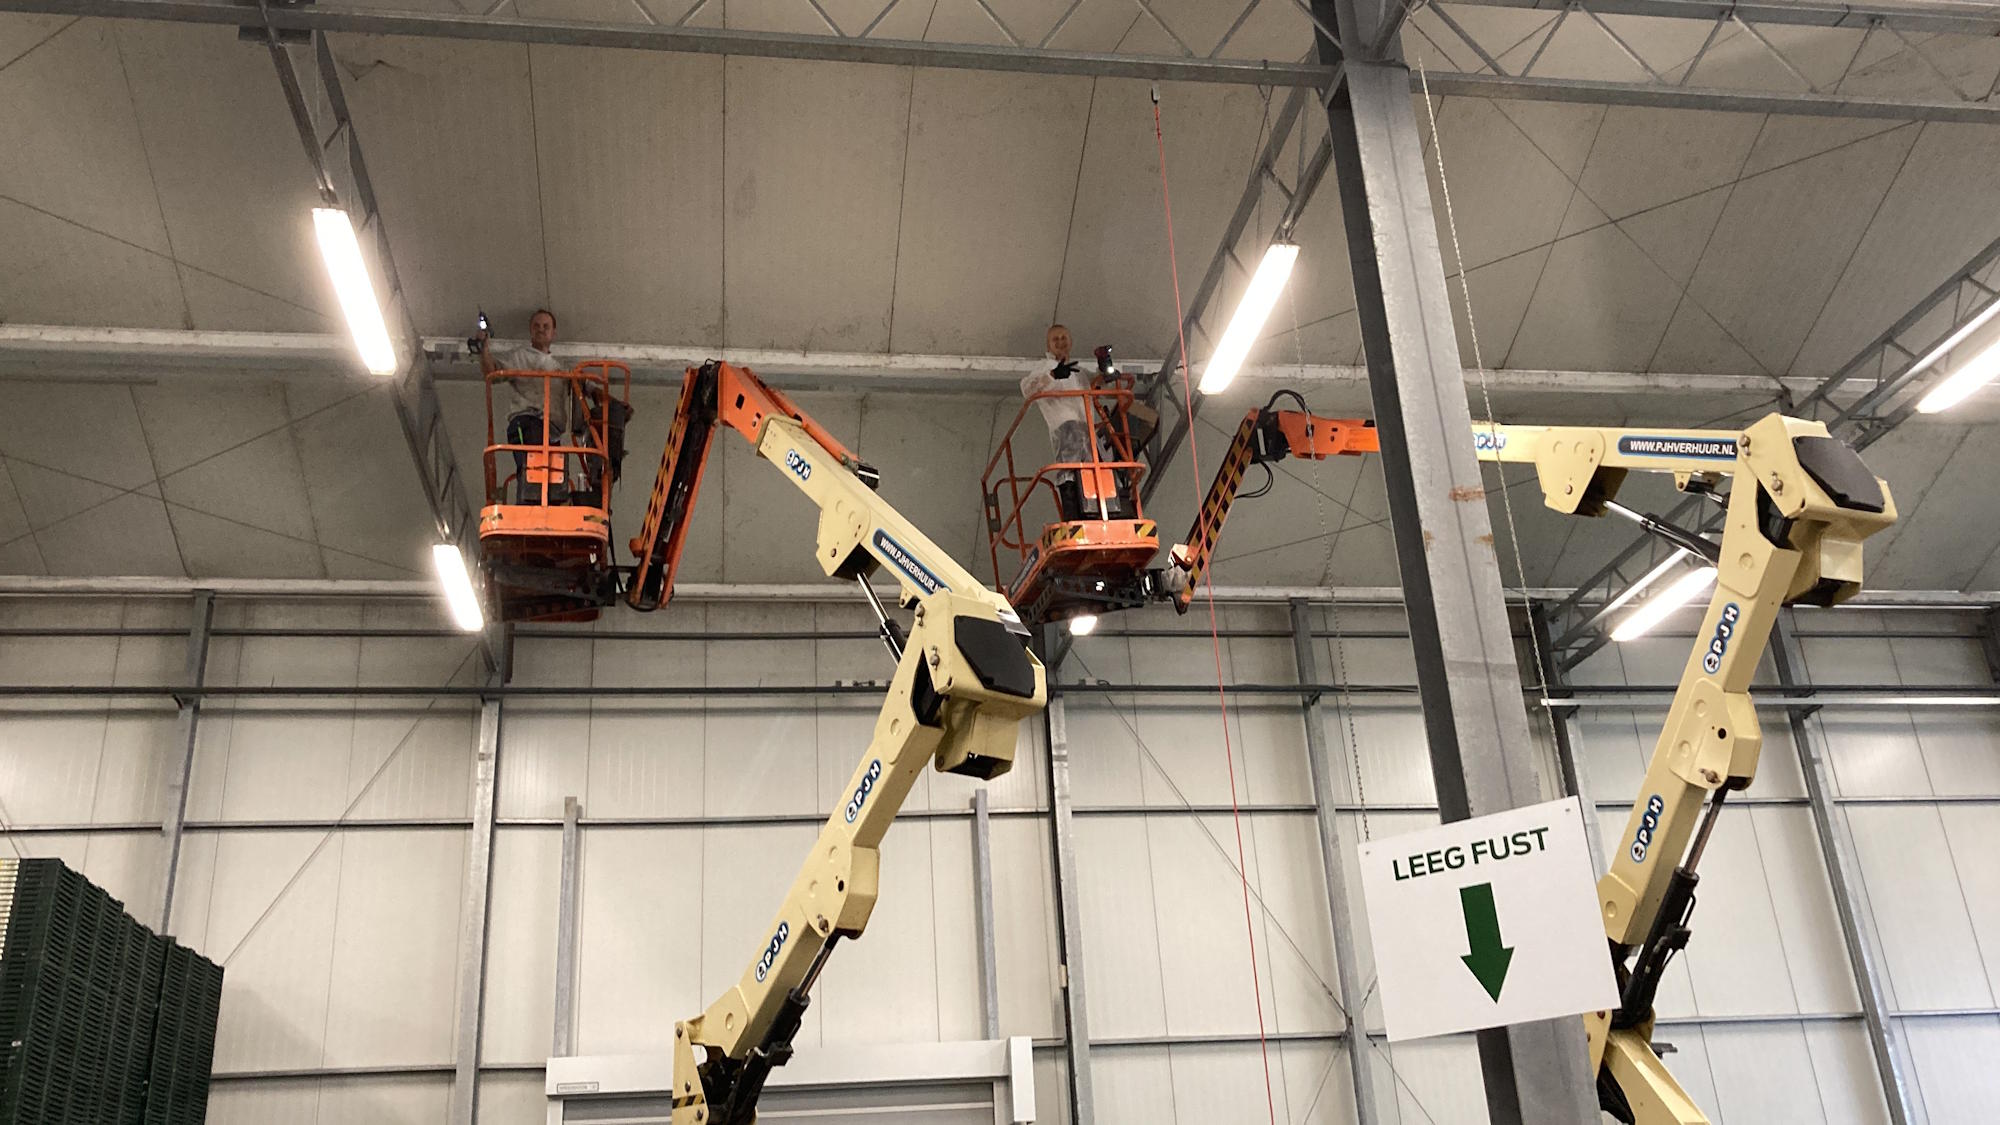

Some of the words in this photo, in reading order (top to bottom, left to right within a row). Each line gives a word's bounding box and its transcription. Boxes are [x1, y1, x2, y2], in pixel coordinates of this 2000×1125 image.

[791, 455, 811, 480] PJH
[1629, 440, 1736, 456] WWW.PJHVERHUUR.NL
[880, 536, 941, 594] WWW.PJHVERHUUR.N
[1711, 605, 1738, 654] PJH
[854, 761, 881, 807] PJH
[1638, 797, 1662, 844] PJH
[1392, 846, 1466, 881] LEEG
[1471, 826, 1549, 865] FUST
[764, 923, 788, 967] PJH
